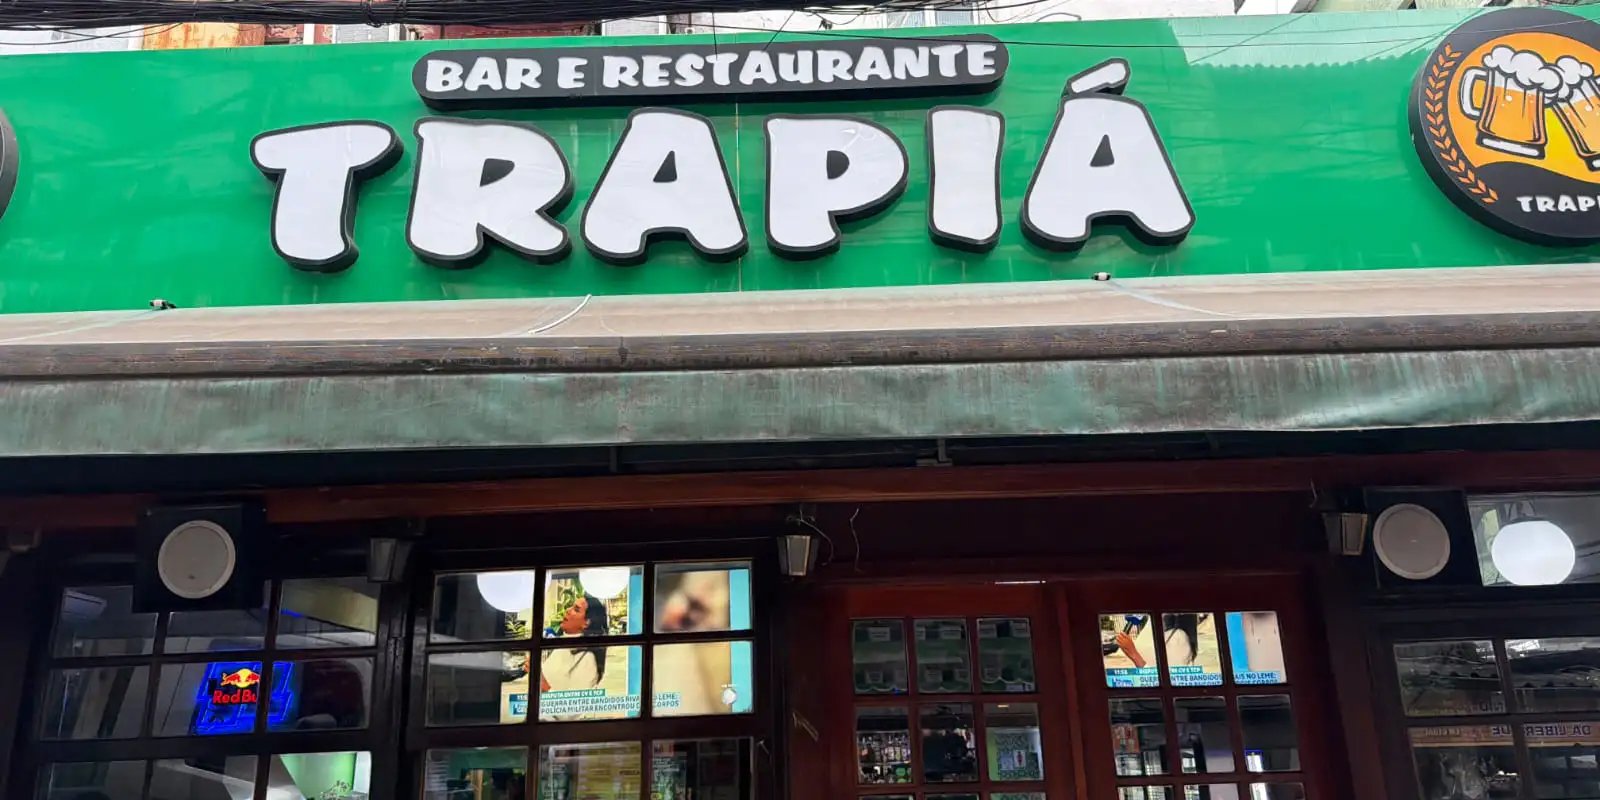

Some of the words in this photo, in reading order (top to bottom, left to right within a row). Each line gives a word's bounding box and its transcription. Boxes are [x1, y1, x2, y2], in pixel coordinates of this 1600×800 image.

[425, 57, 542, 92] BAR
[557, 57, 588, 89] E
[602, 43, 998, 88] RESTAURANTE
[250, 57, 1196, 272] TRAPIÁ
[213, 690, 240, 704] Red
[541, 699, 568, 707] GUERRA
[569, 698, 590, 706] ENTRE
[591, 696, 624, 704] BANDIDOS
[567, 704, 594, 713] MILITAR
[595, 703, 634, 712] ENCONTROU
